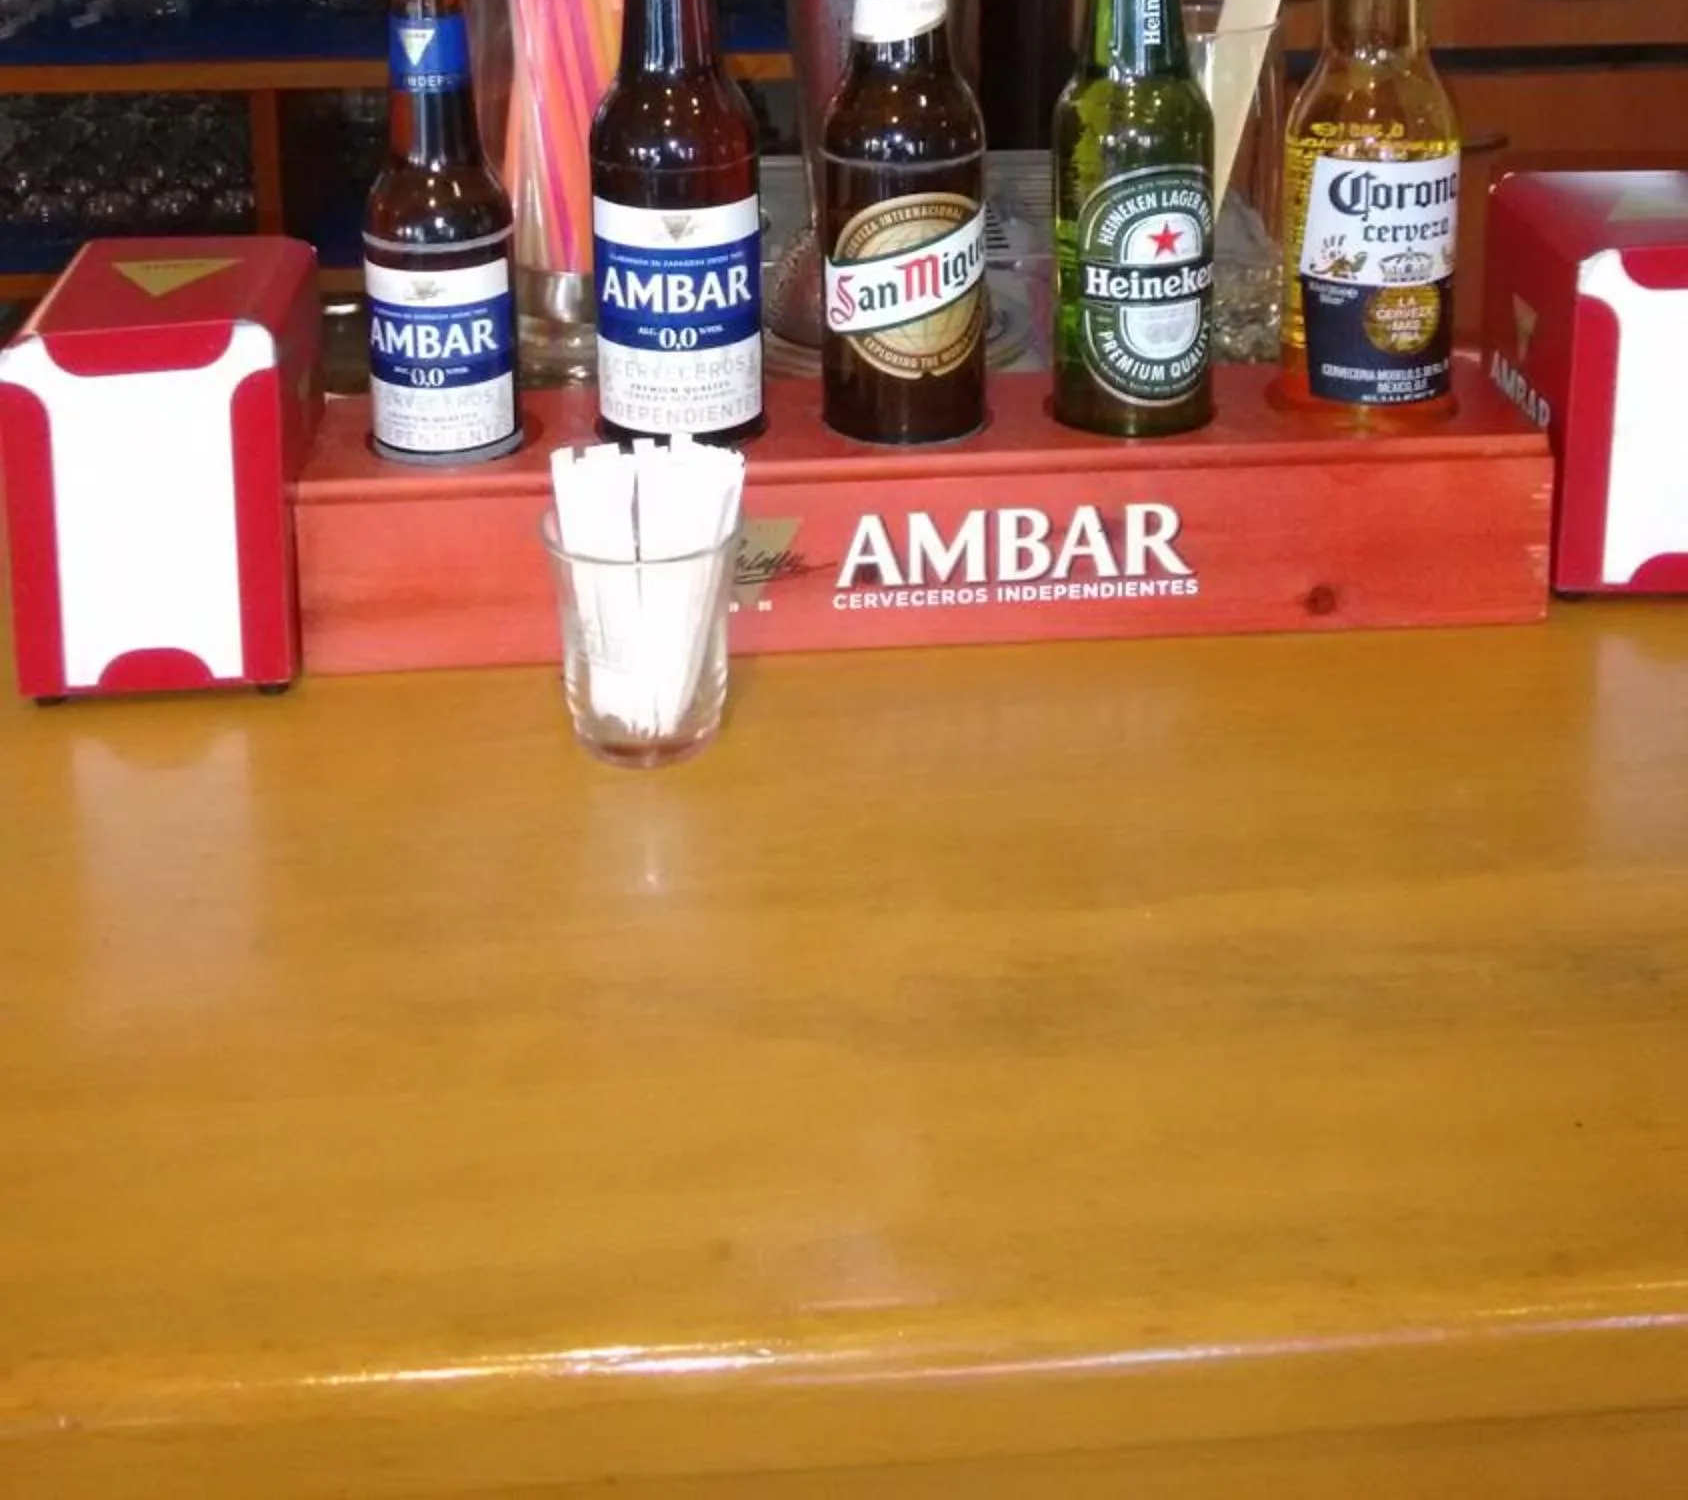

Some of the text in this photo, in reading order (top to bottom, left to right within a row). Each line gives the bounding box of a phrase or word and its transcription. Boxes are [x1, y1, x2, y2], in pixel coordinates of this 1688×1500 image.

[1098, 192, 1158, 246] HEINEKEN
[1161, 189, 1200, 208] LAGER
[603, 264, 753, 314] AMBAR
[829, 238, 985, 325] San Migu
[370, 316, 500, 359] AMBAR
[1098, 330, 1167, 382] PREMIUM
[834, 502, 1196, 590] AMBAR
[832, 578, 1199, 611] CERVECEROS INDEPENDIENTES
